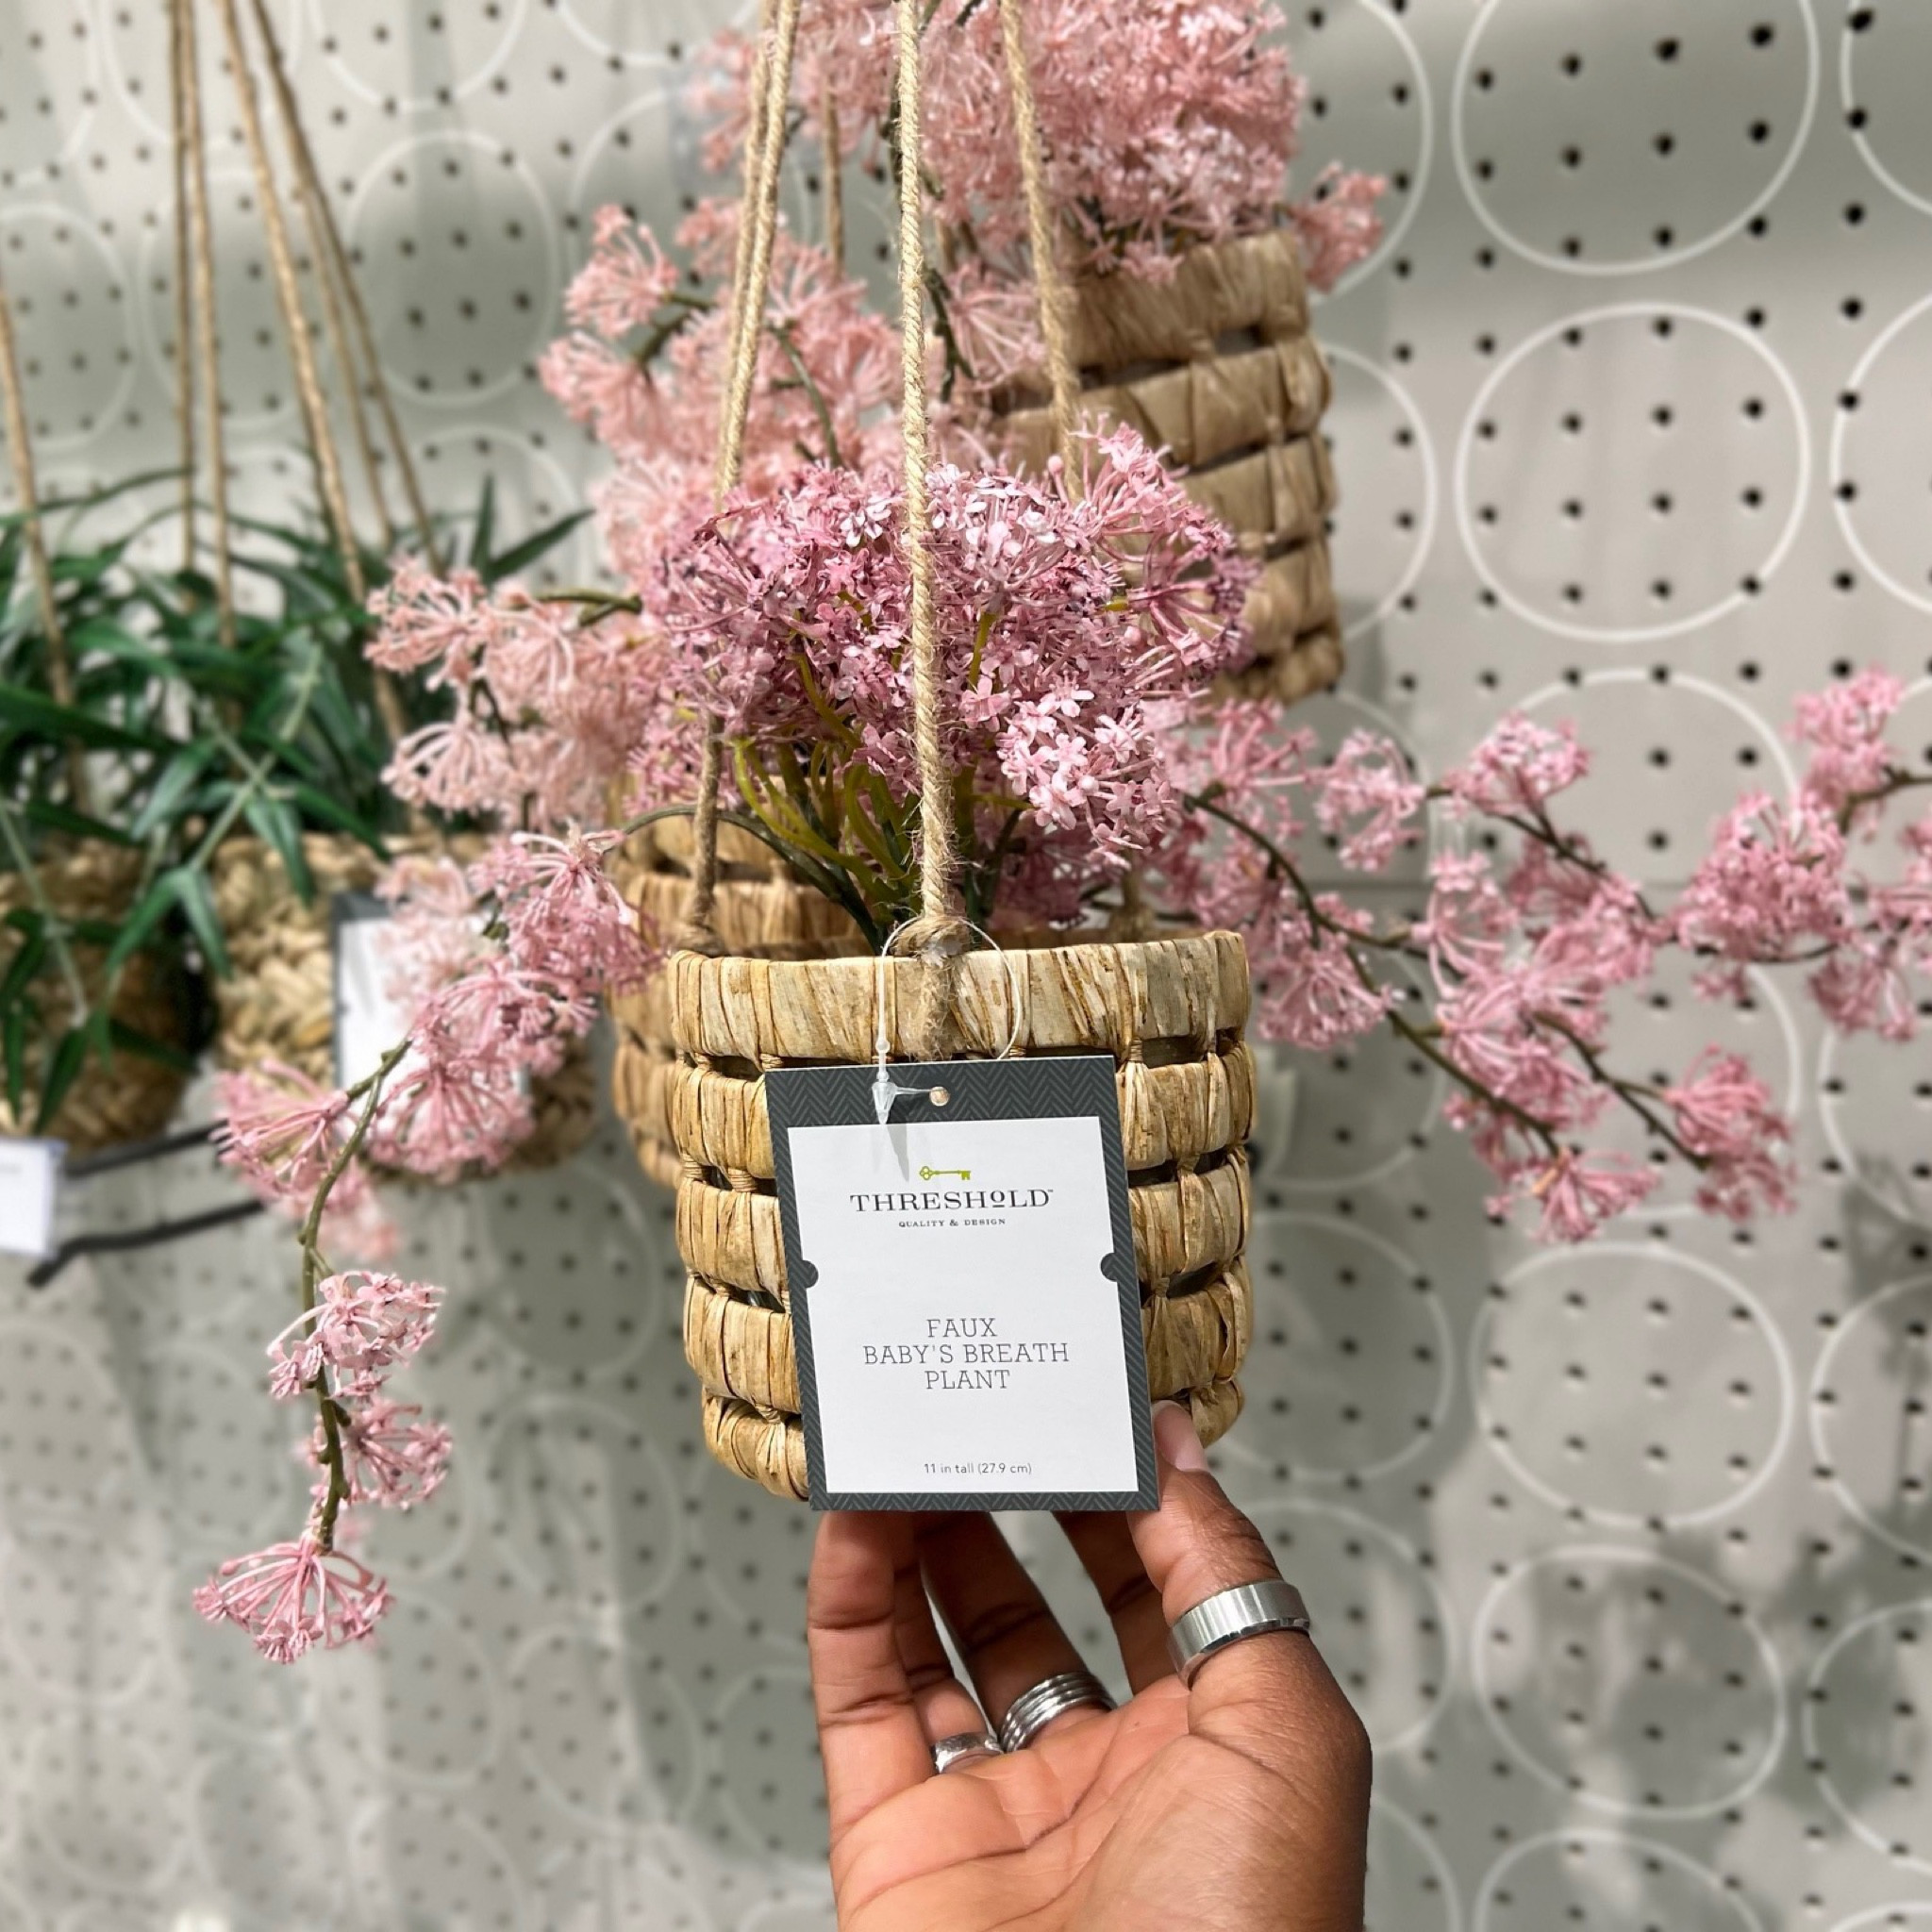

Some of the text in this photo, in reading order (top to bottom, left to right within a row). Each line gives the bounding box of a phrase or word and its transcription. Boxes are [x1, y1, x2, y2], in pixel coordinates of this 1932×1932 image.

[898, 1219, 944, 1227] QUALITY
[964, 1218, 1006, 1226] DESIGN
[926, 1317, 997, 1338] FAUX
[863, 1342, 1069, 1364] BABY'S BREATH
[924, 1369, 1010, 1390] PLANT
[924, 1462, 1032, 1475] 11 in tall (27.9 cm)
